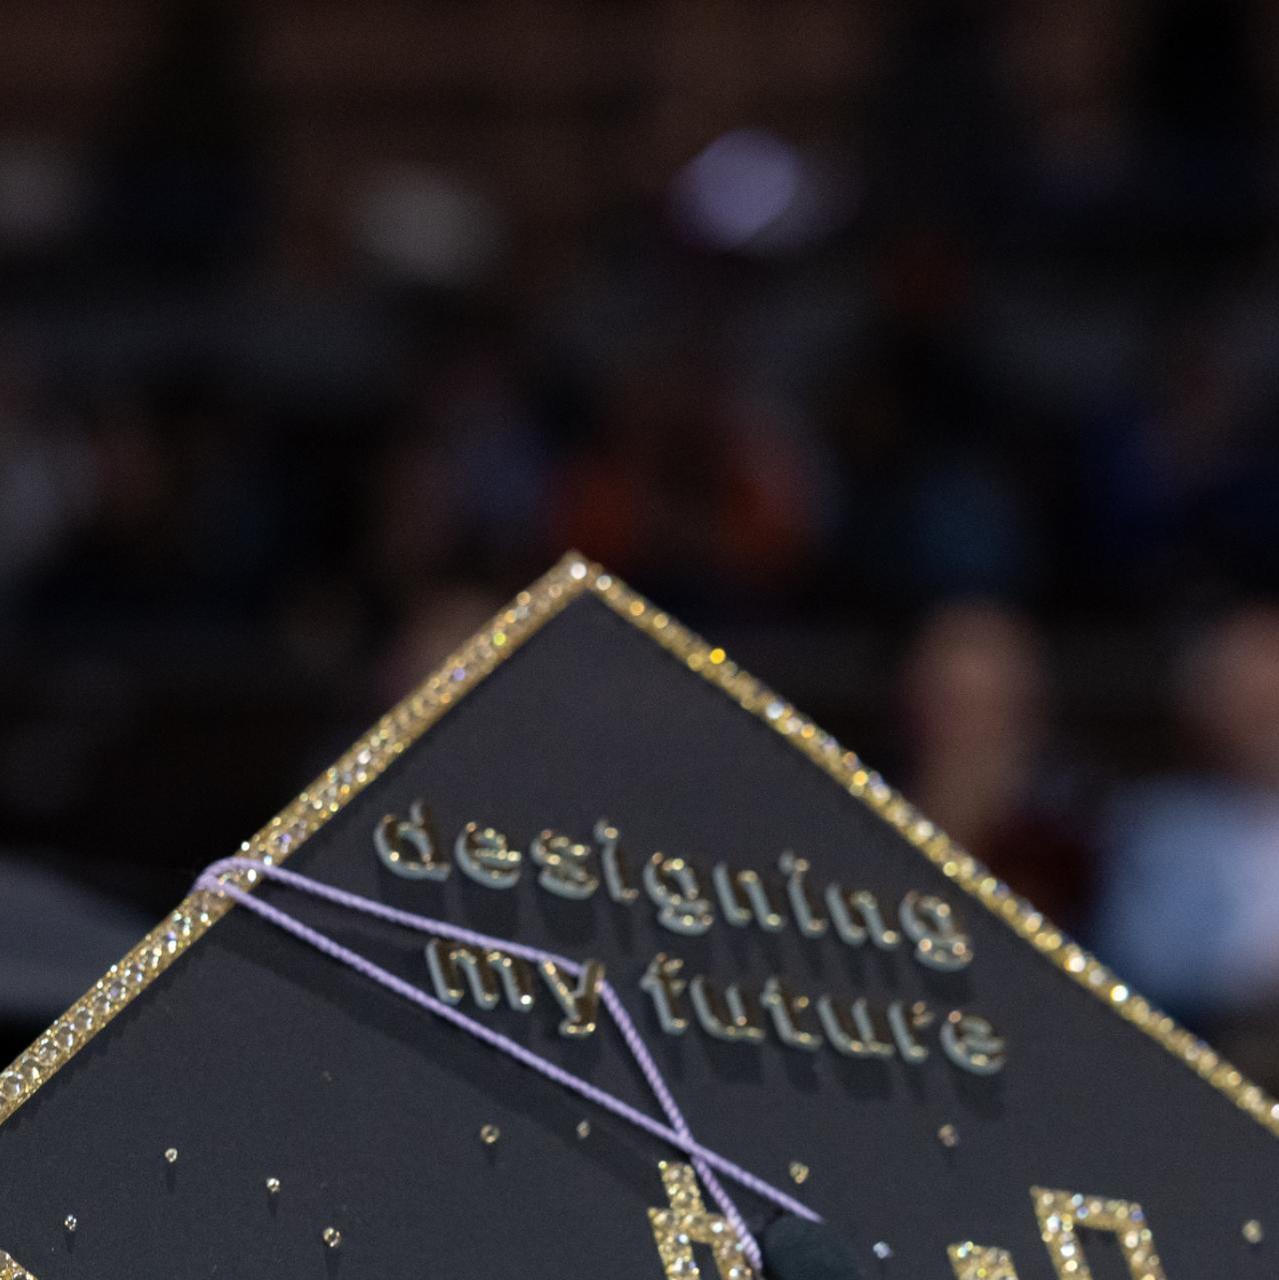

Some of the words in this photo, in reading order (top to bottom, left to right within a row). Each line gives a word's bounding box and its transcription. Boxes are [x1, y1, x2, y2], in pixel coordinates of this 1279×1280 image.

[374, 799, 972, 970] designing
[425, 939, 606, 1037] my
[640, 953, 1006, 1076] future
